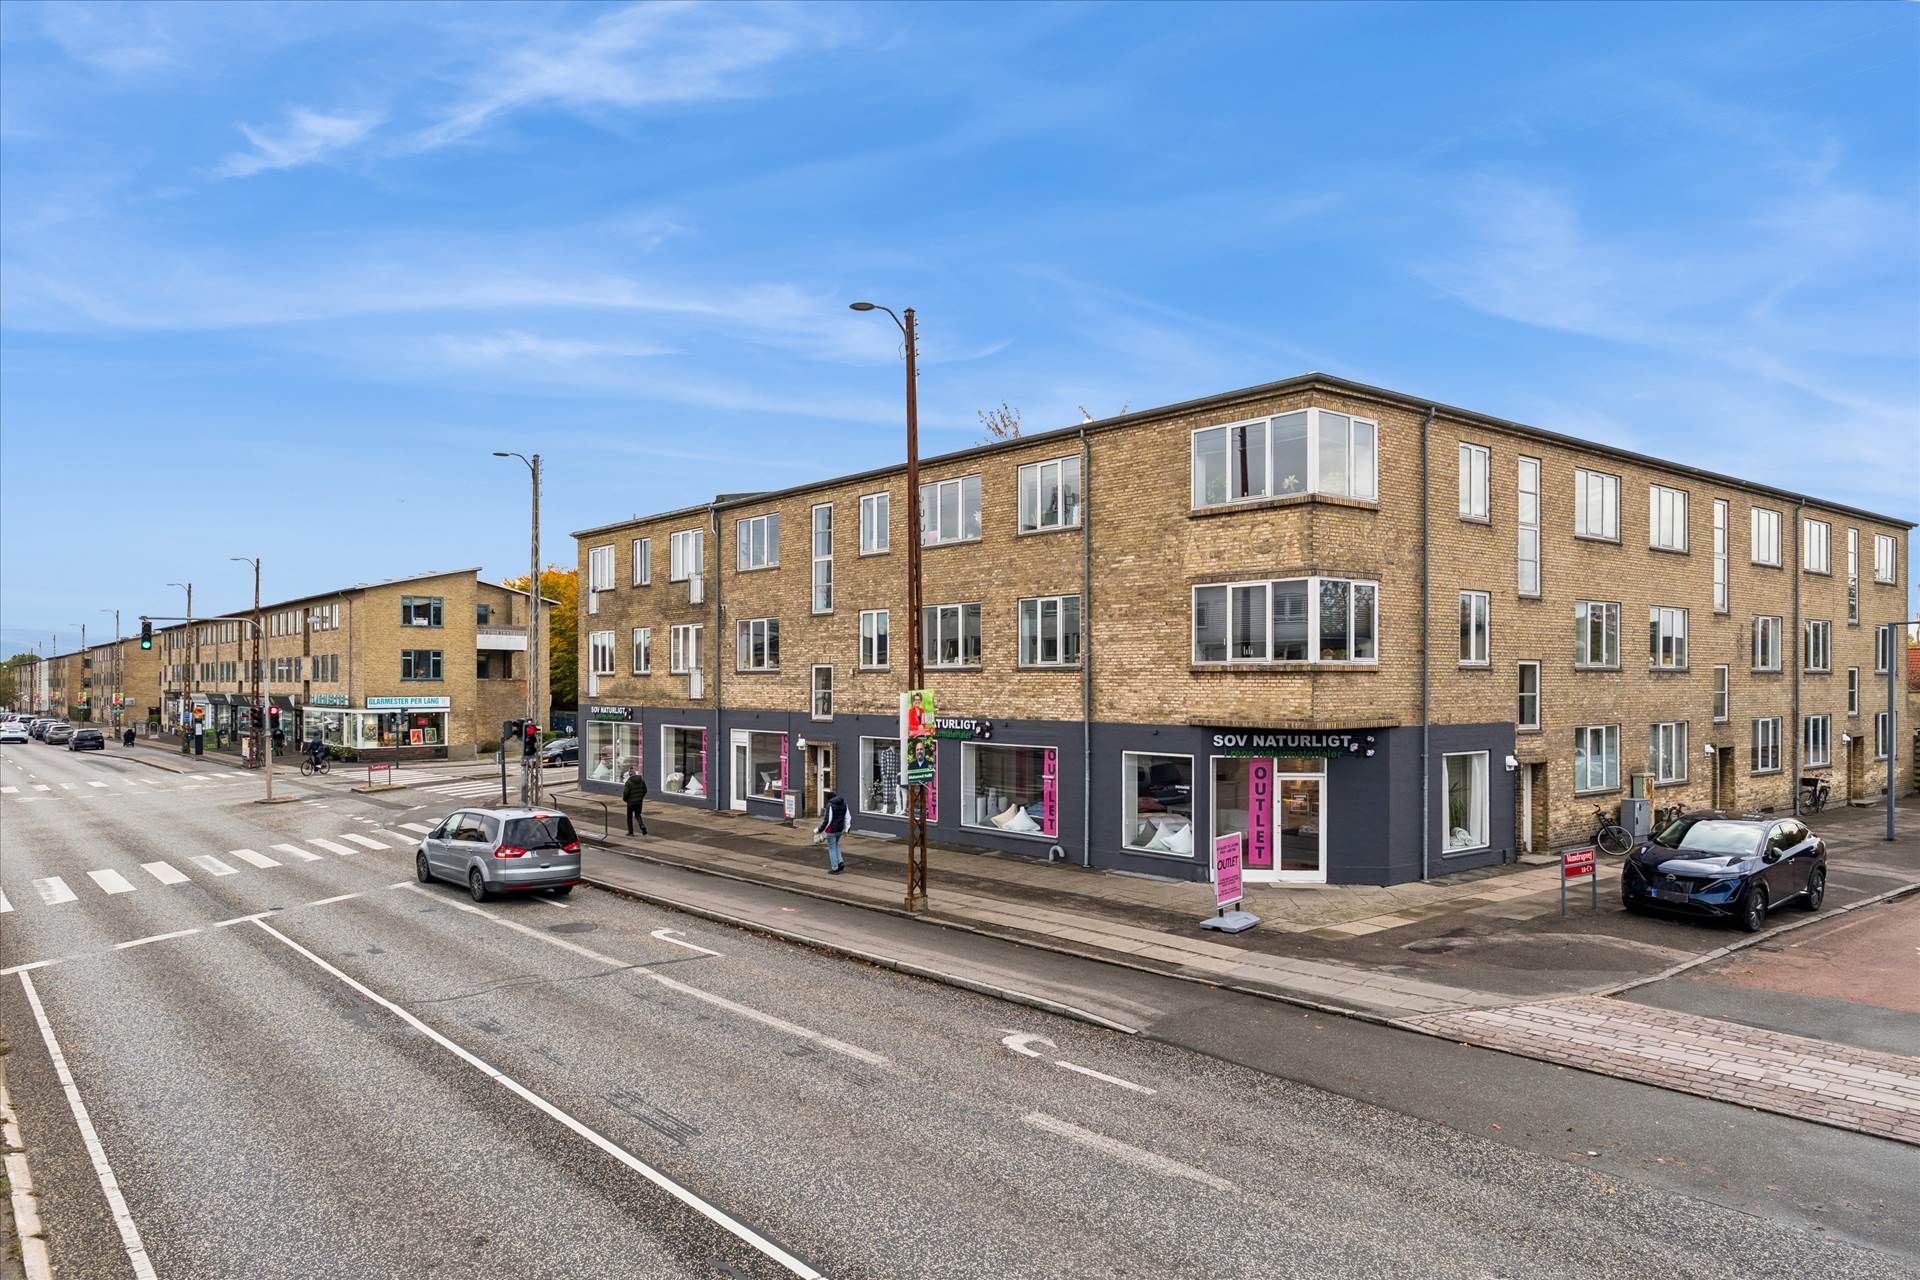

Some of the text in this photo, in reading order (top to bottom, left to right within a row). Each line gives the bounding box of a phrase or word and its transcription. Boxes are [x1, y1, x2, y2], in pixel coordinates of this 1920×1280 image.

[934, 719, 977, 731] TURLIGT
[1213, 735, 1351, 747] SOV NATURLIGT
[1048, 750, 1056, 830] OUTLET
[1254, 766, 1267, 859] OUTLET
[1217, 855, 1239, 871] OUTLET
